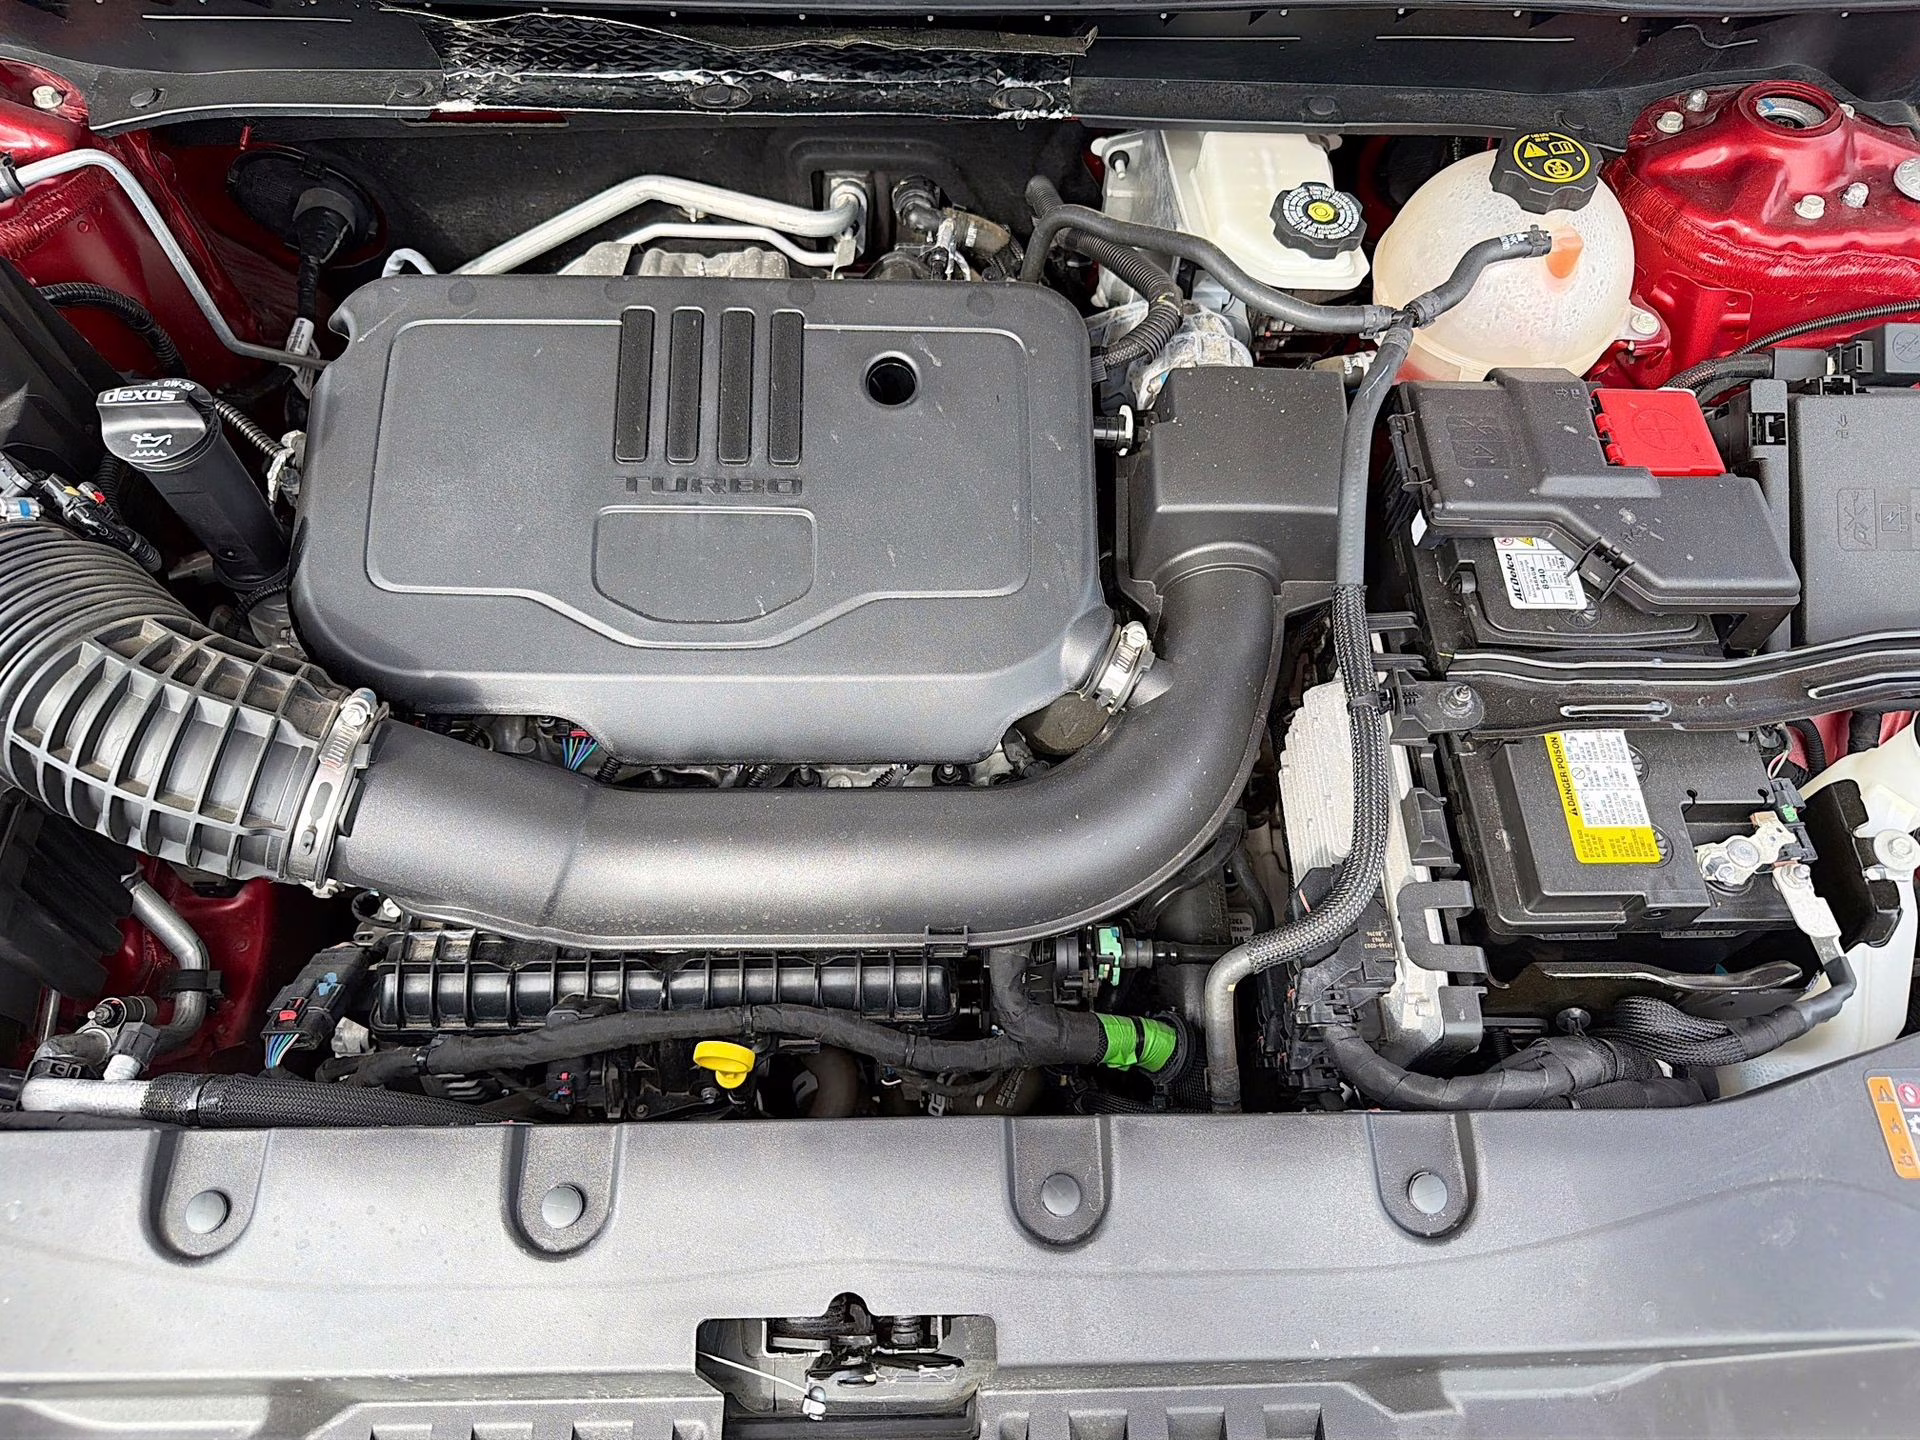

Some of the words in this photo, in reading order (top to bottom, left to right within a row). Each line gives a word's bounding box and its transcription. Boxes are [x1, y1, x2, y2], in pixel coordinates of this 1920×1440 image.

[103, 387, 177, 403] dexos
[163, 380, 196, 391] 0W-20
[613, 476, 803, 496] TURBO
[1505, 553, 1524, 602] ACDelco
[1537, 568, 1550, 590] 8540
[1550, 736, 1567, 770] POISON
[1559, 770, 1577, 807] DANGER
